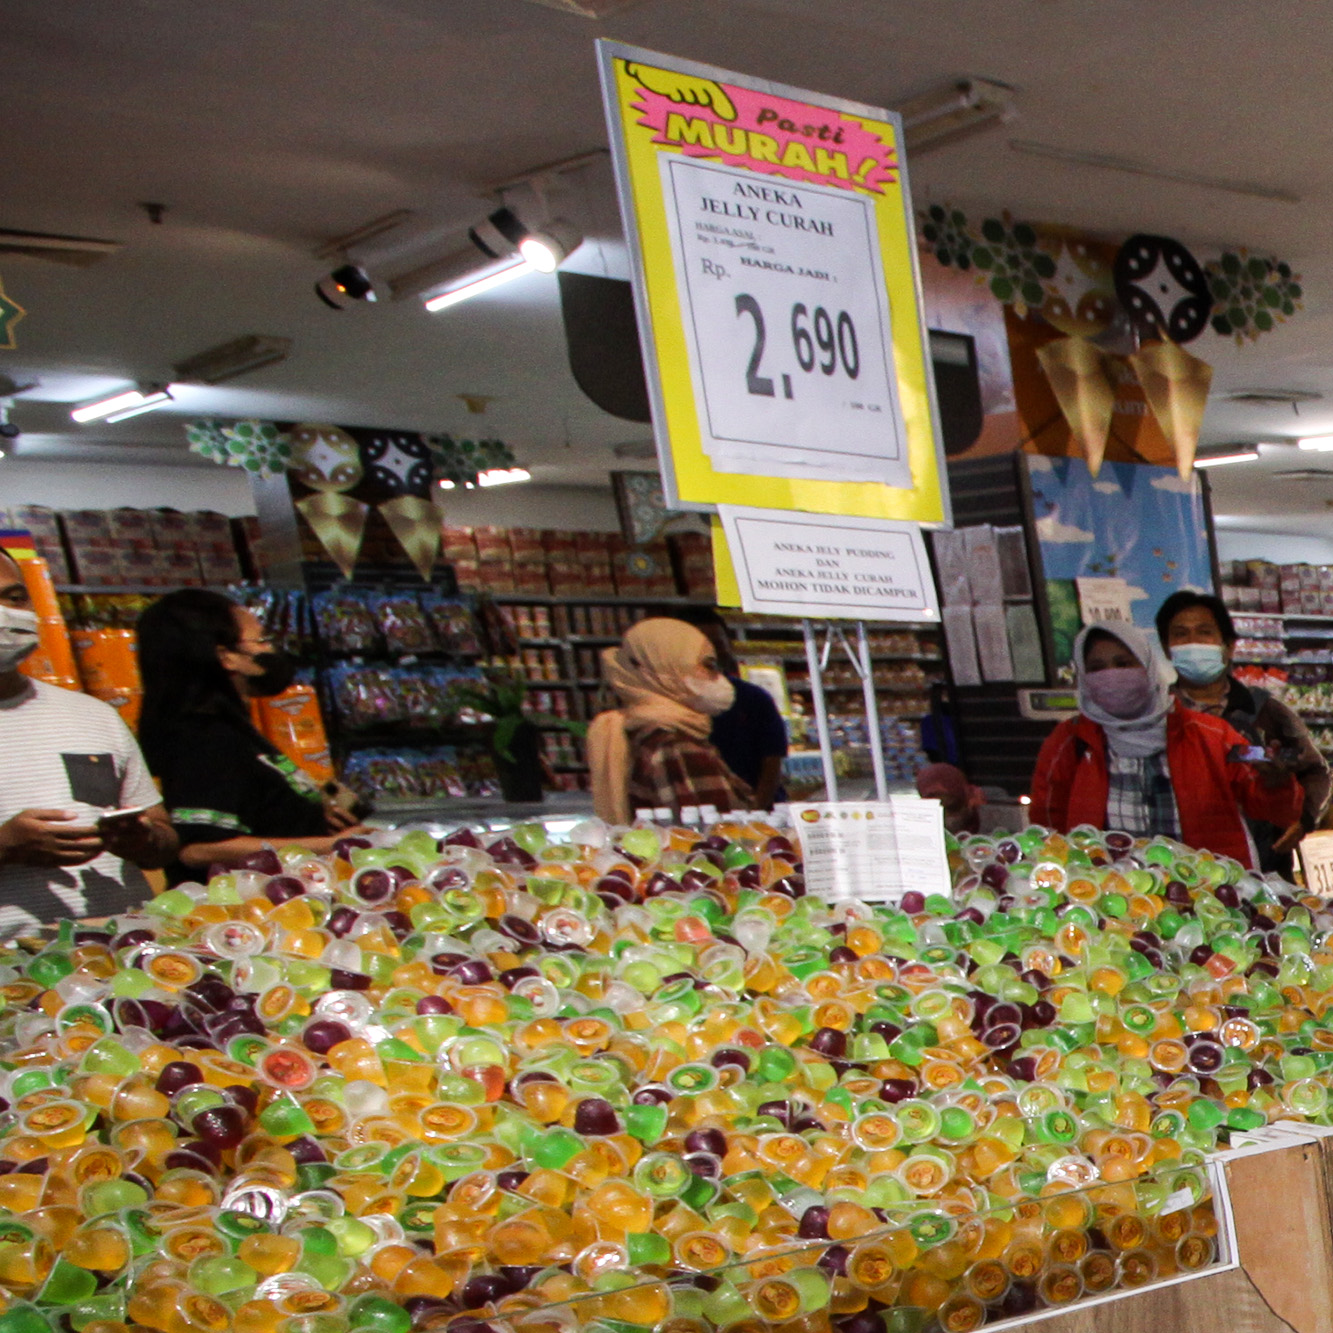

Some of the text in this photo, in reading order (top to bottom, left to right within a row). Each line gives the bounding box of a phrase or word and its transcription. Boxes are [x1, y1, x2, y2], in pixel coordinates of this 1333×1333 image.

[757, 108, 846, 143] Pasti
[666, 112, 877, 184] MURAH!
[733, 182, 802, 209] ANEKA
[700, 197, 835, 237] JELLY CURAH
[701, 257, 731, 280] Rp.
[740, 256, 795, 274] HARGA
[816, 559, 840, 568] DAN
[845, 548, 896, 560] PUDDING
[775, 568, 814, 578] ANEKA
[854, 572, 893, 583] CURAH
[757, 580, 918, 599] MOHON TIDAK DICAMPUR
